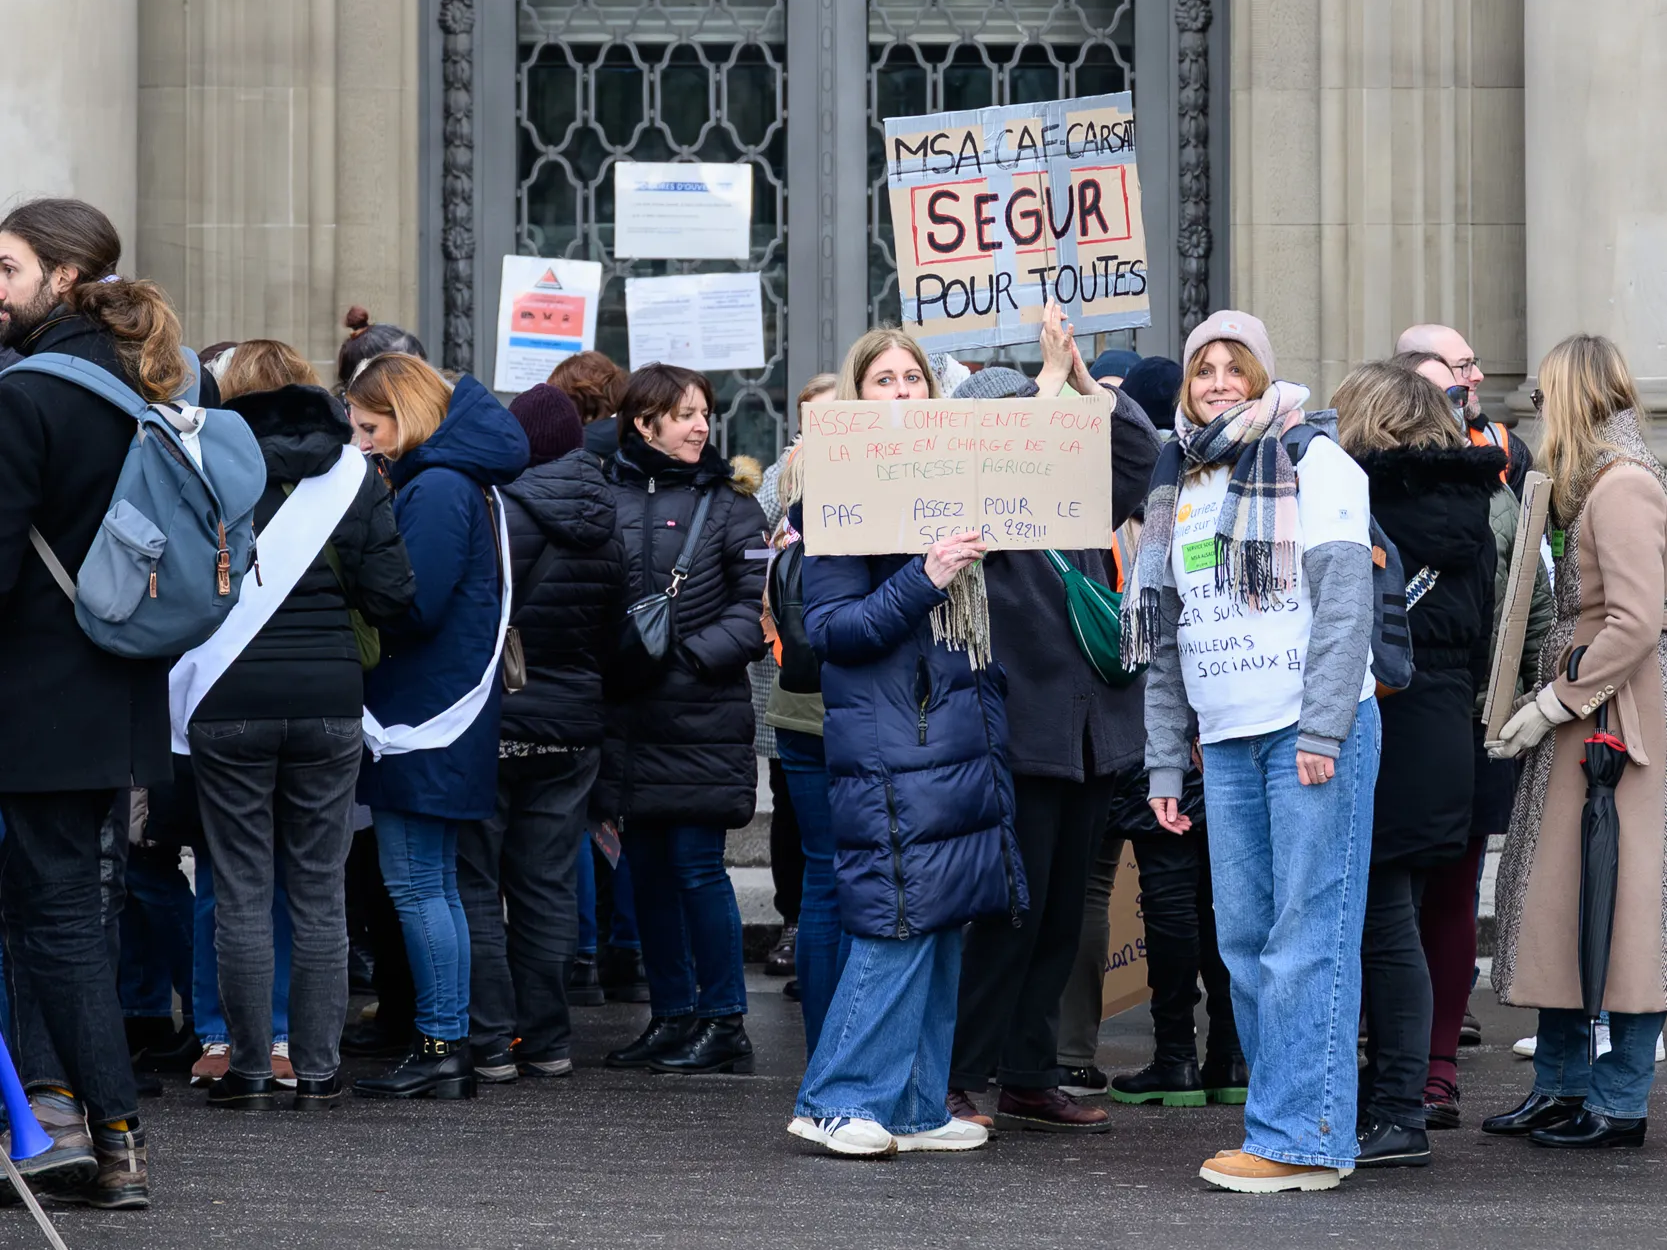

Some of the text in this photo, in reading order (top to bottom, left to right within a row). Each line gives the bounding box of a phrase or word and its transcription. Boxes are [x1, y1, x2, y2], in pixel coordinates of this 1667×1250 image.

[926, 177, 1109, 253] SEGUR
[915, 254, 1147, 326] POUR TOUTES
[809, 409, 883, 436] ASSEZ
[1049, 410, 1102, 433] POUR
[828, 444, 850, 462] LA
[912, 434, 938, 452] EN
[947, 436, 1015, 452] CHARGE
[1024, 438, 1046, 452] DE
[1059, 440, 1084, 455] LA
[876, 457, 1055, 481] DETRESSE AGRICOLE
[821, 496, 1082, 528] PAS ASSEZ POUR LE
[919, 524, 999, 546] SEGR
[1193, 519, 1212, 533] sur
[1213, 603, 1244, 622] SUR
